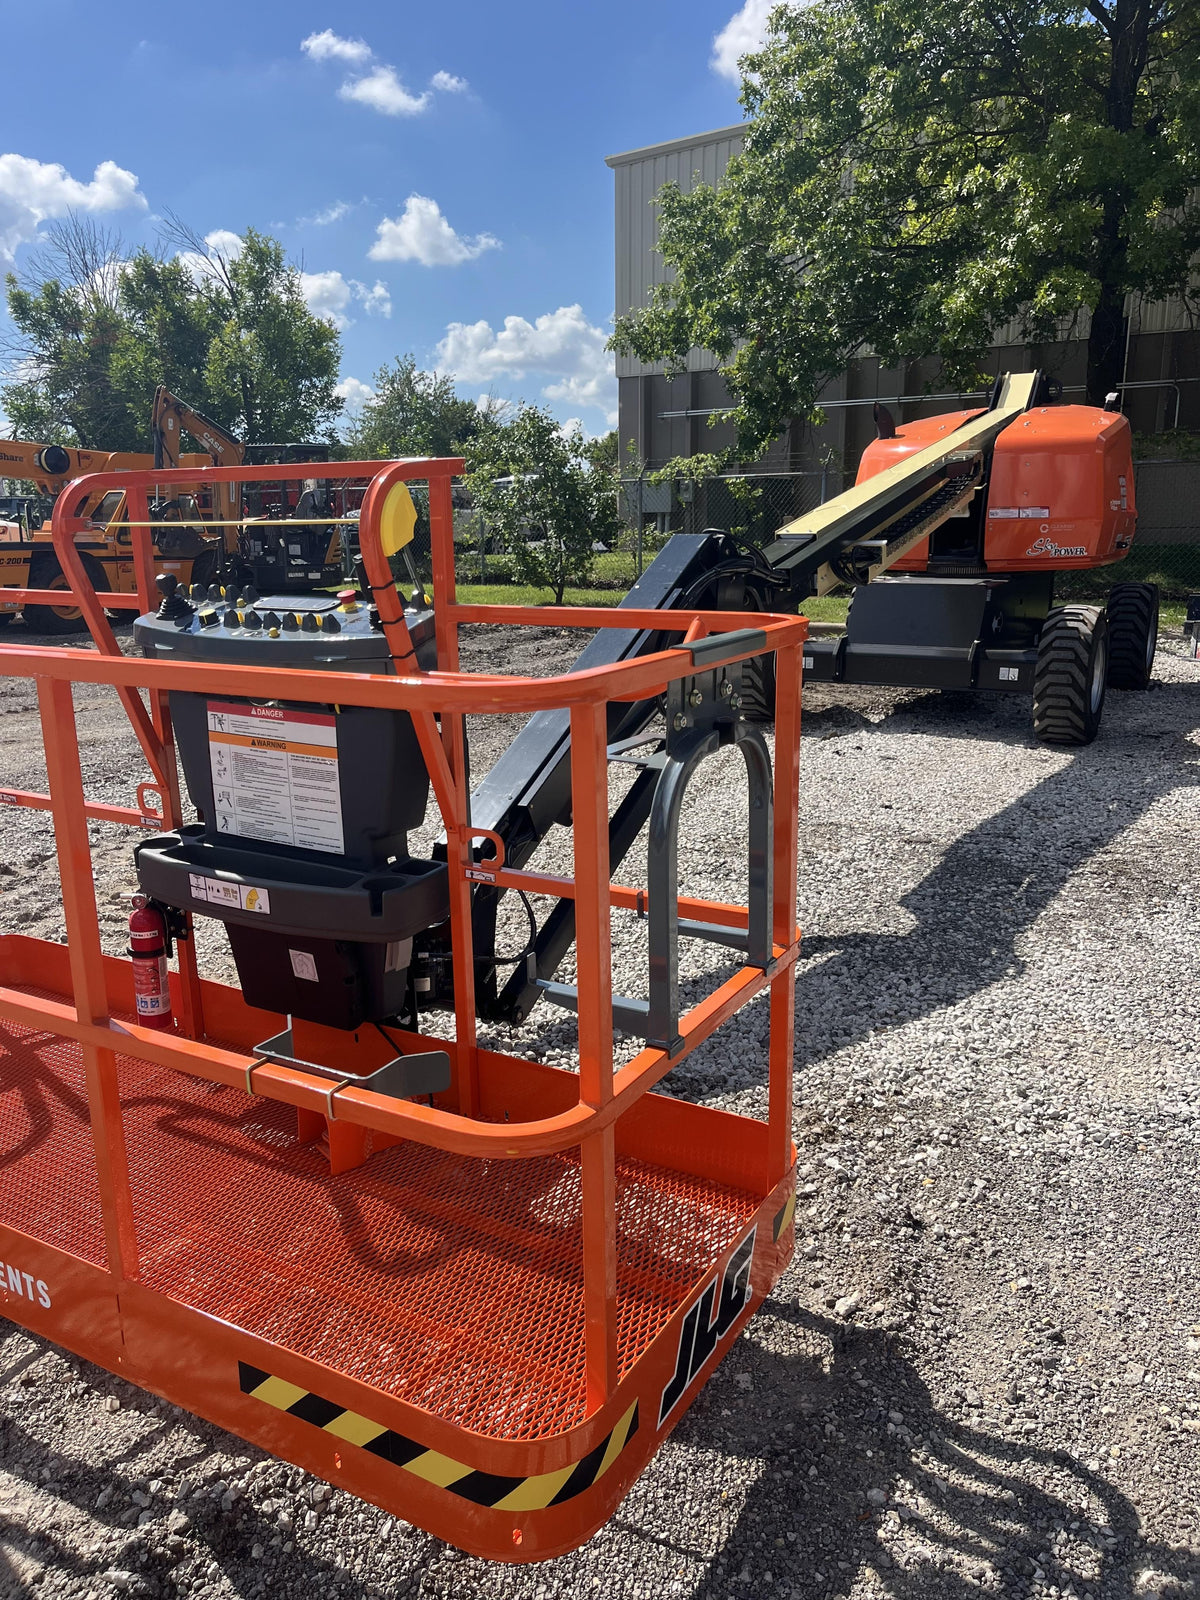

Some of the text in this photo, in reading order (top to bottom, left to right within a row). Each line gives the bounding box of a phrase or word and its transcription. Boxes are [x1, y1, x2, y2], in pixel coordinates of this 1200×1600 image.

[203, 432, 225, 453] CASE
[257, 708, 284, 719] DANGER
[257, 739, 287, 750] WARNING
[656, 1222, 758, 1431] JLG
